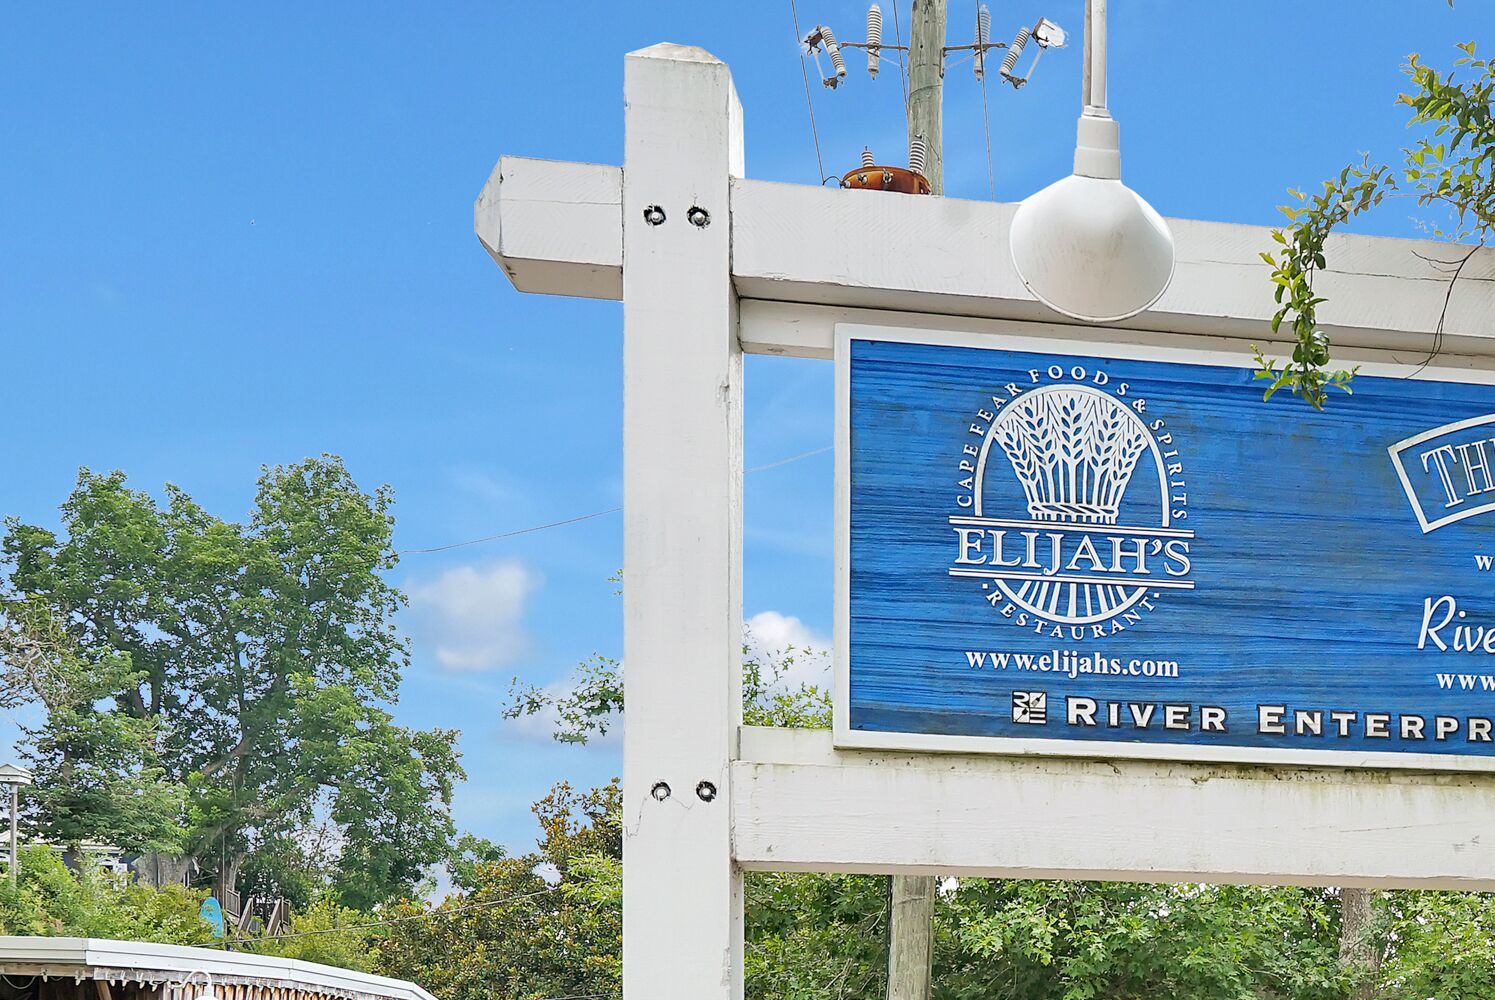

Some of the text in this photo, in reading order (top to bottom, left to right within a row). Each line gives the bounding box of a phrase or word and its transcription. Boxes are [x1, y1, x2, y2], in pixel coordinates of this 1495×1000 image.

[956, 443, 978, 507] CAPE
[970, 382, 1023, 437] FEAR
[1028, 364, 1131, 396] FOODS
[1149, 419, 1188, 520] SPIRITS
[953, 528, 1191, 577] ELIJAH'S
[986, 589, 1154, 641] RESTAURANT
[964, 649, 1179, 679] www.elijahs.com
[1066, 695, 1229, 733] RIVER
